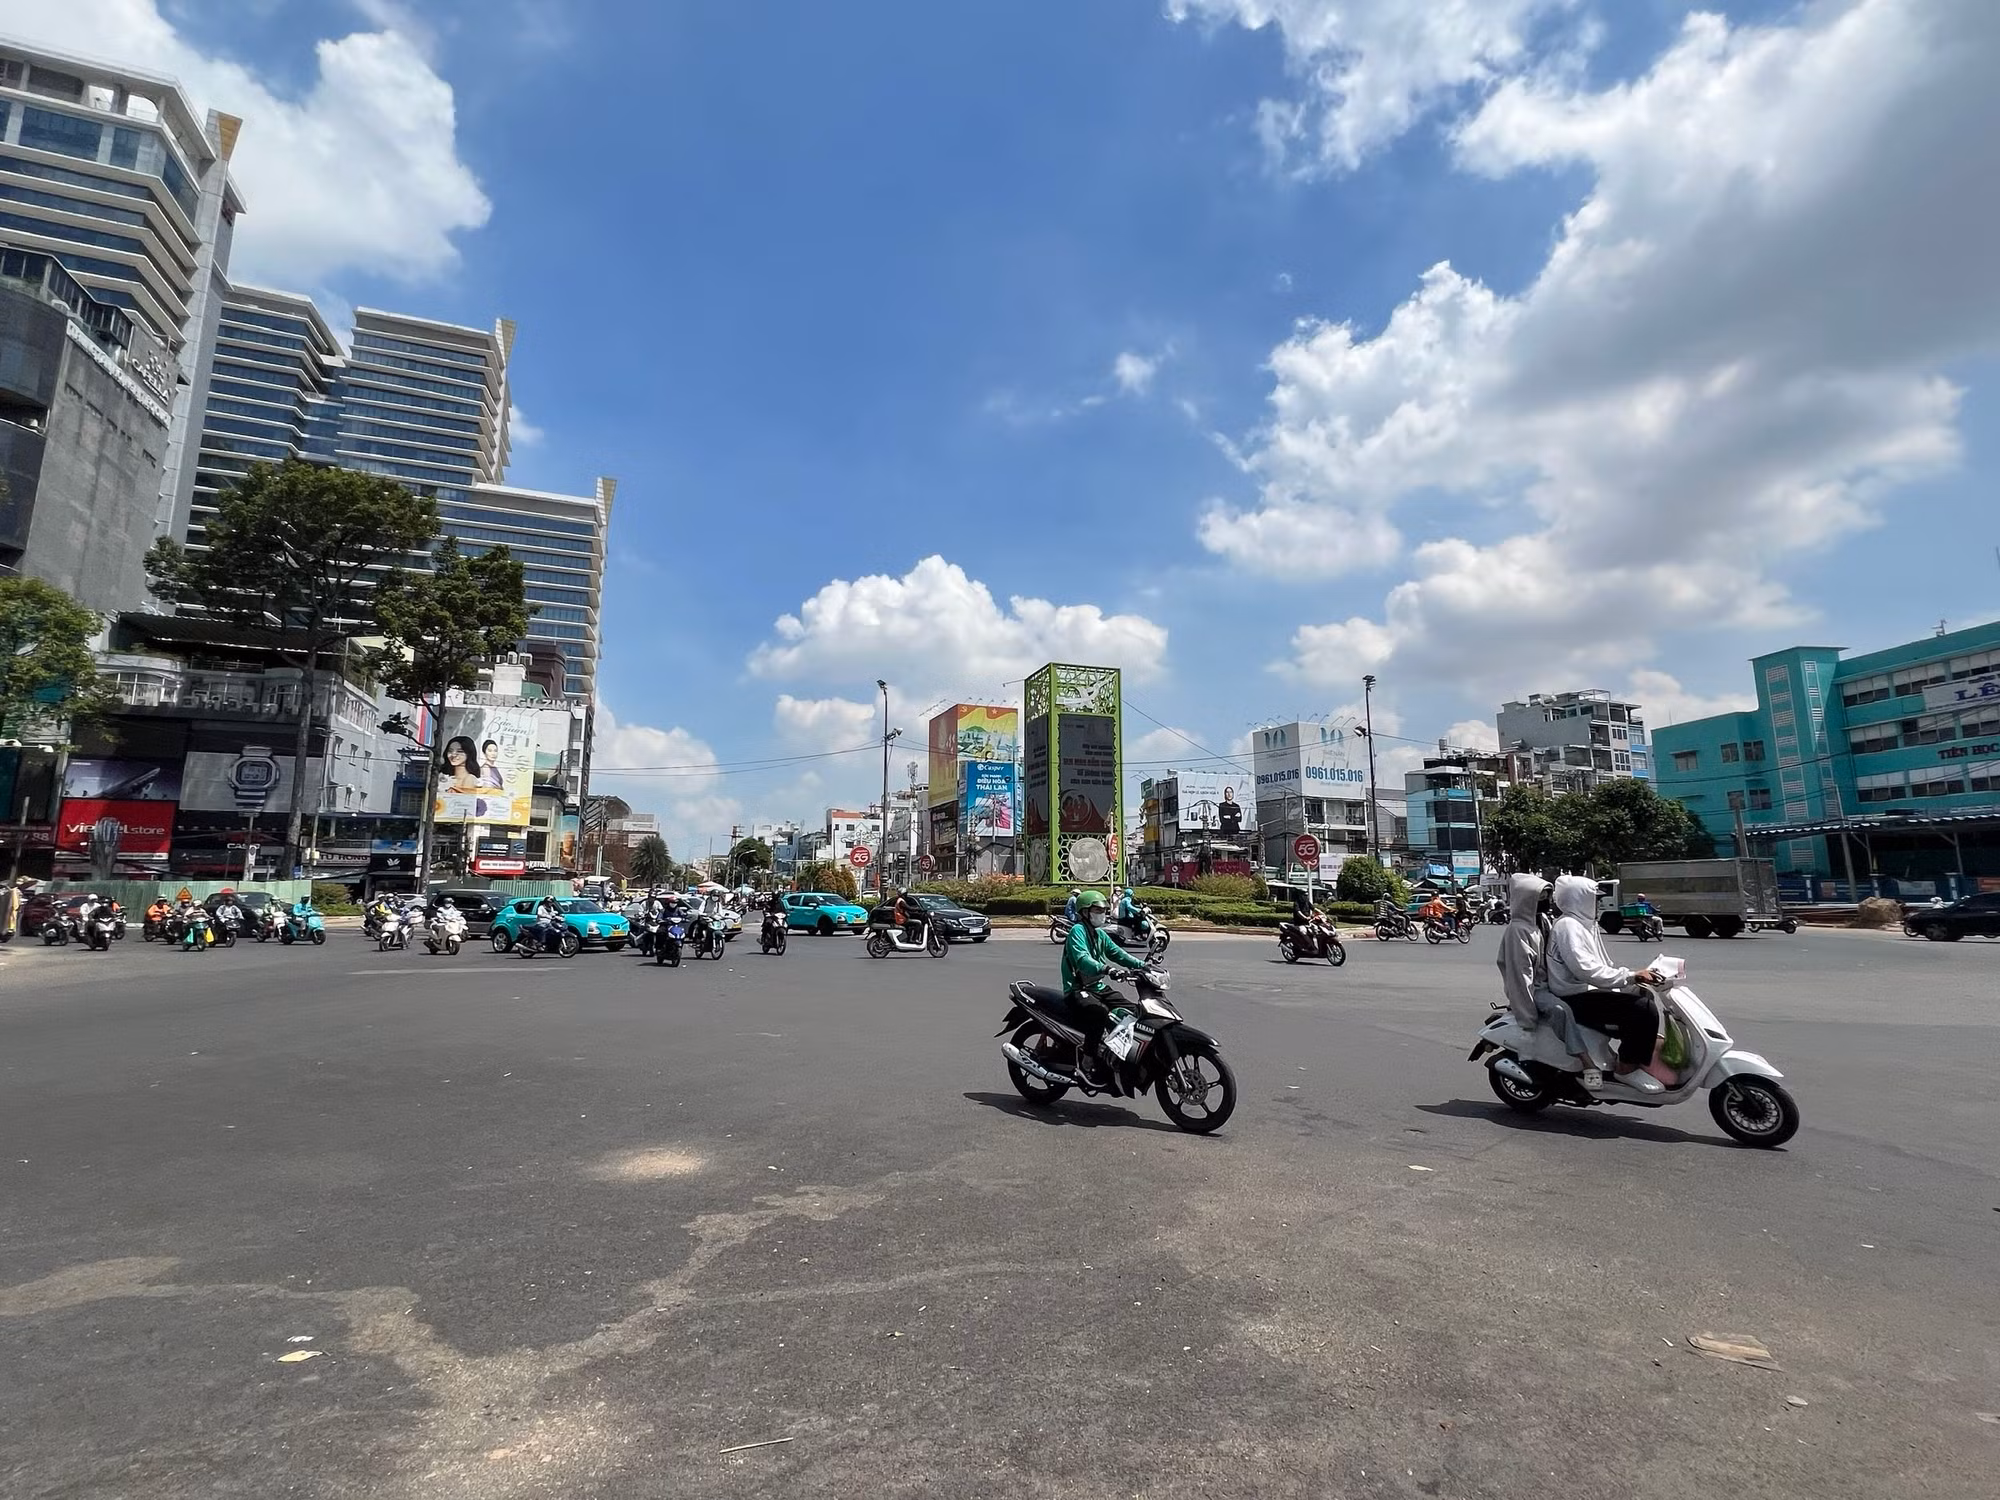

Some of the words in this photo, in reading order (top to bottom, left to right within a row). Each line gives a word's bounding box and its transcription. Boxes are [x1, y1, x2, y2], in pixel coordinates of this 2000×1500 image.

[542, 699, 567, 710] ZIM
[1256, 768, 1300, 785] 0961.015.016
[1305, 766, 1363, 782] 0961.015.016
[1298, 843, 1316, 856] 5G
[854, 852, 869, 862] 5G
[1136, 1022, 1155, 1034] YAMAHA
